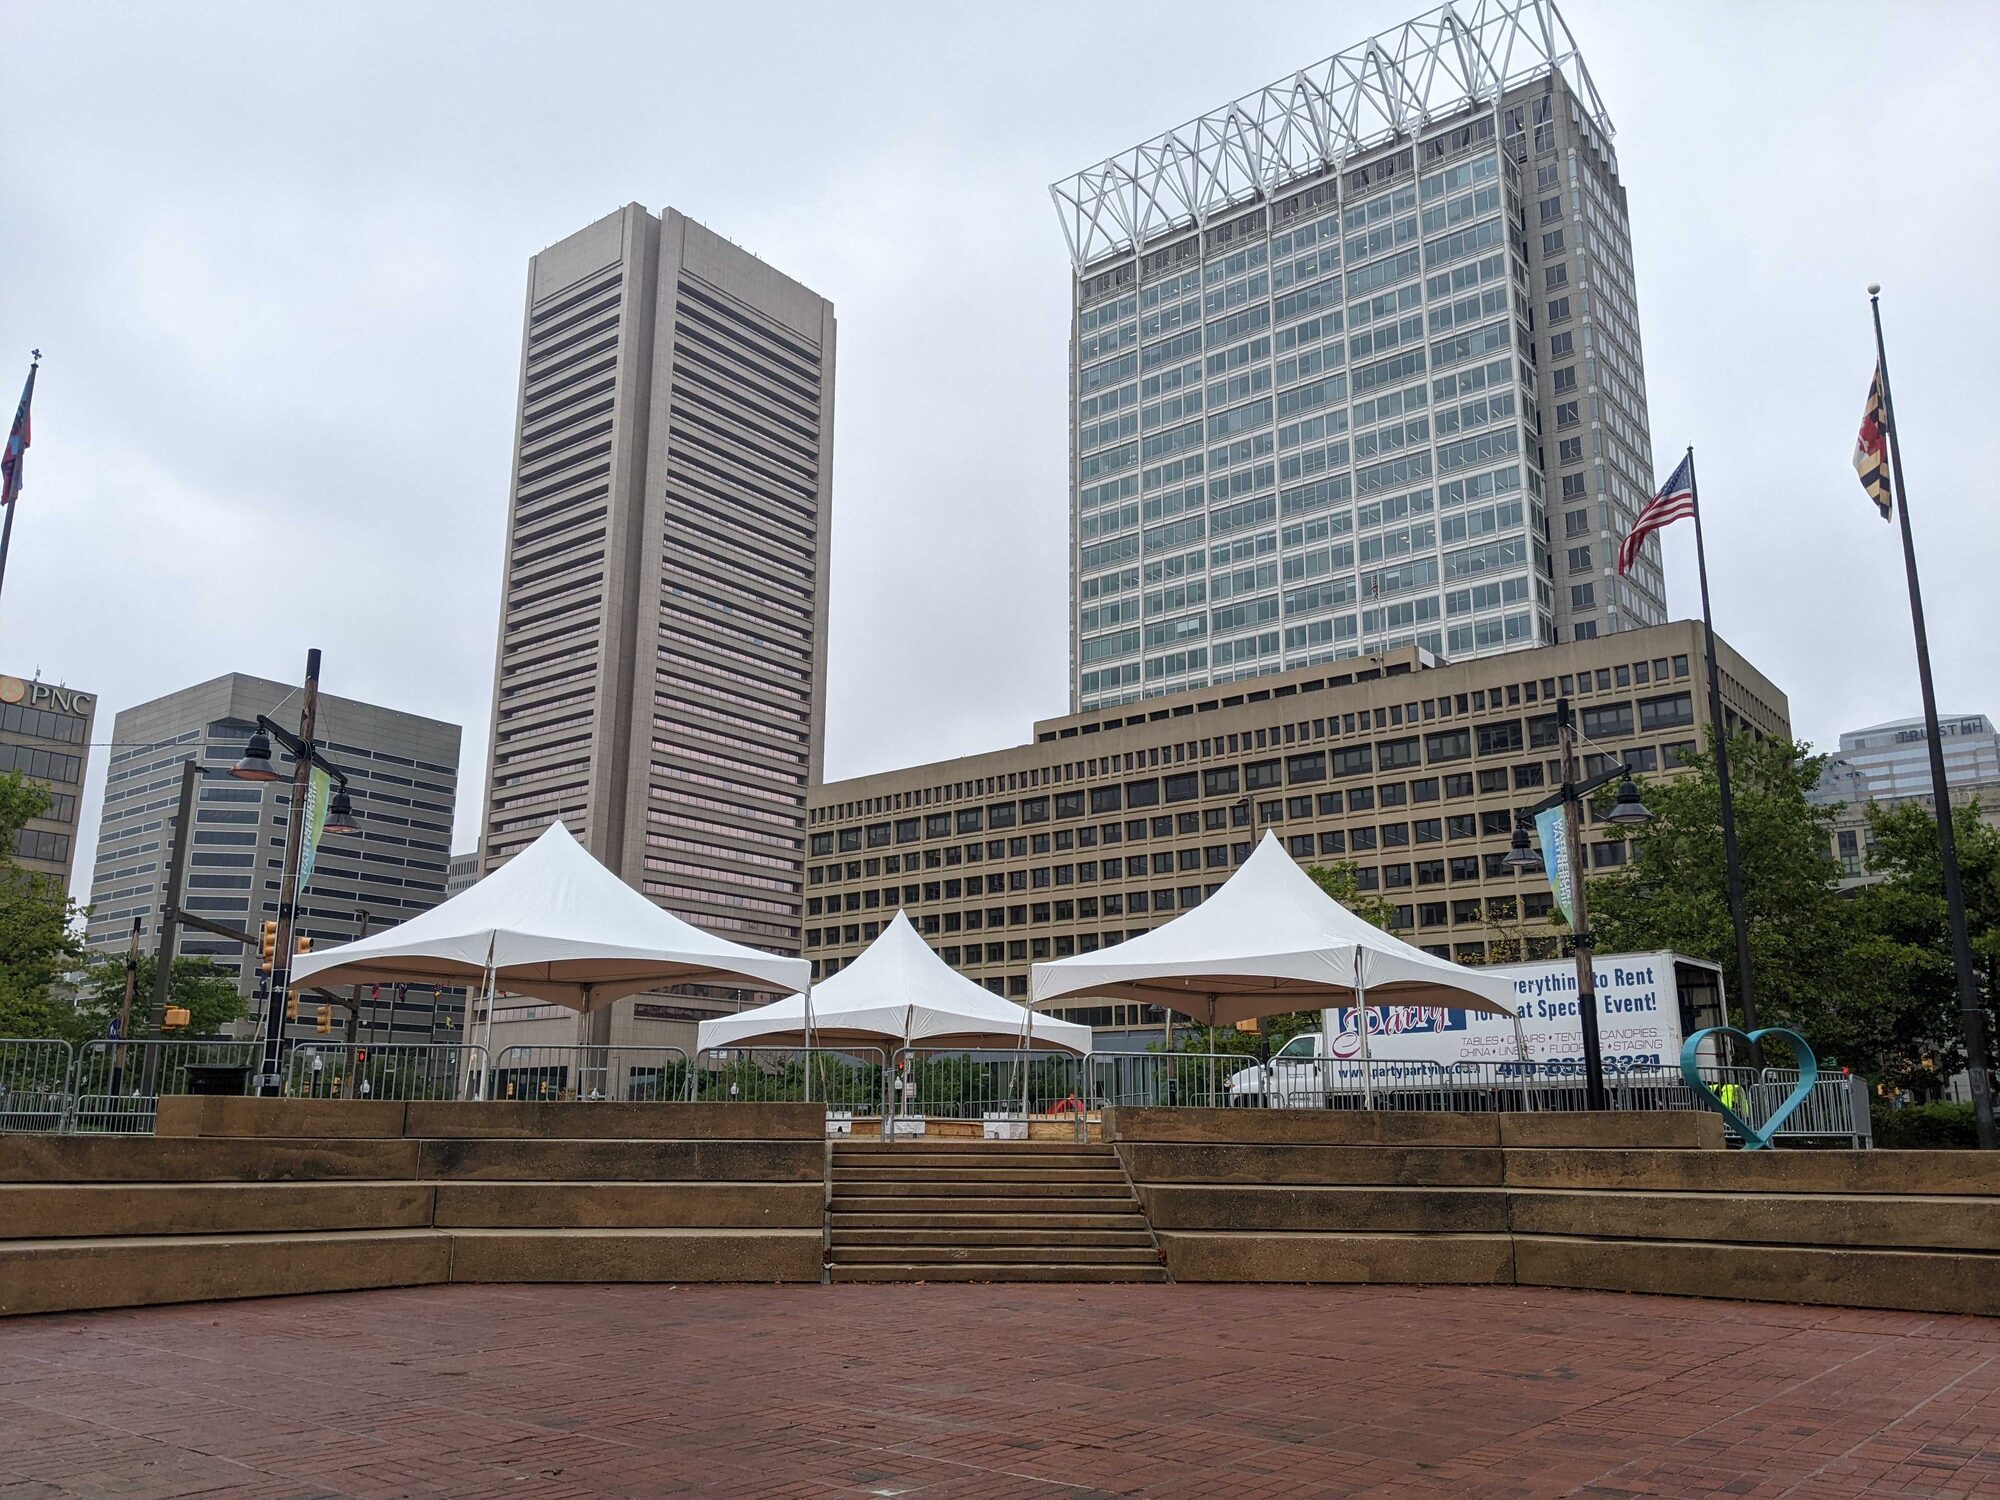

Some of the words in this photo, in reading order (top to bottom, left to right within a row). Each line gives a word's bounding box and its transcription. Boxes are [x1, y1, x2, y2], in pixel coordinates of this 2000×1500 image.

[30, 683, 91, 715] PNC
[1896, 724, 1957, 743] TRUST
[1513, 973, 1576, 998] erythin
[1591, 971, 1609, 989] to
[1614, 966, 1655, 988] Rent
[1538, 998, 1582, 1021] Speci
[1605, 991, 1657, 1014] Event!
[1460, 1047, 1491, 1058] CHINA
[1499, 1045, 1536, 1056] LINES
[1550, 1042, 1605, 1054] FLOORG
[1613, 1039, 1663, 1051] STAGING
[1461, 1036, 1499, 1047] TABLES
[1507, 1034, 1546, 1045] CAIRS
[1554, 1032, 1584, 1042] TENT
[1600, 1028, 1658, 1040] CANOPIES
